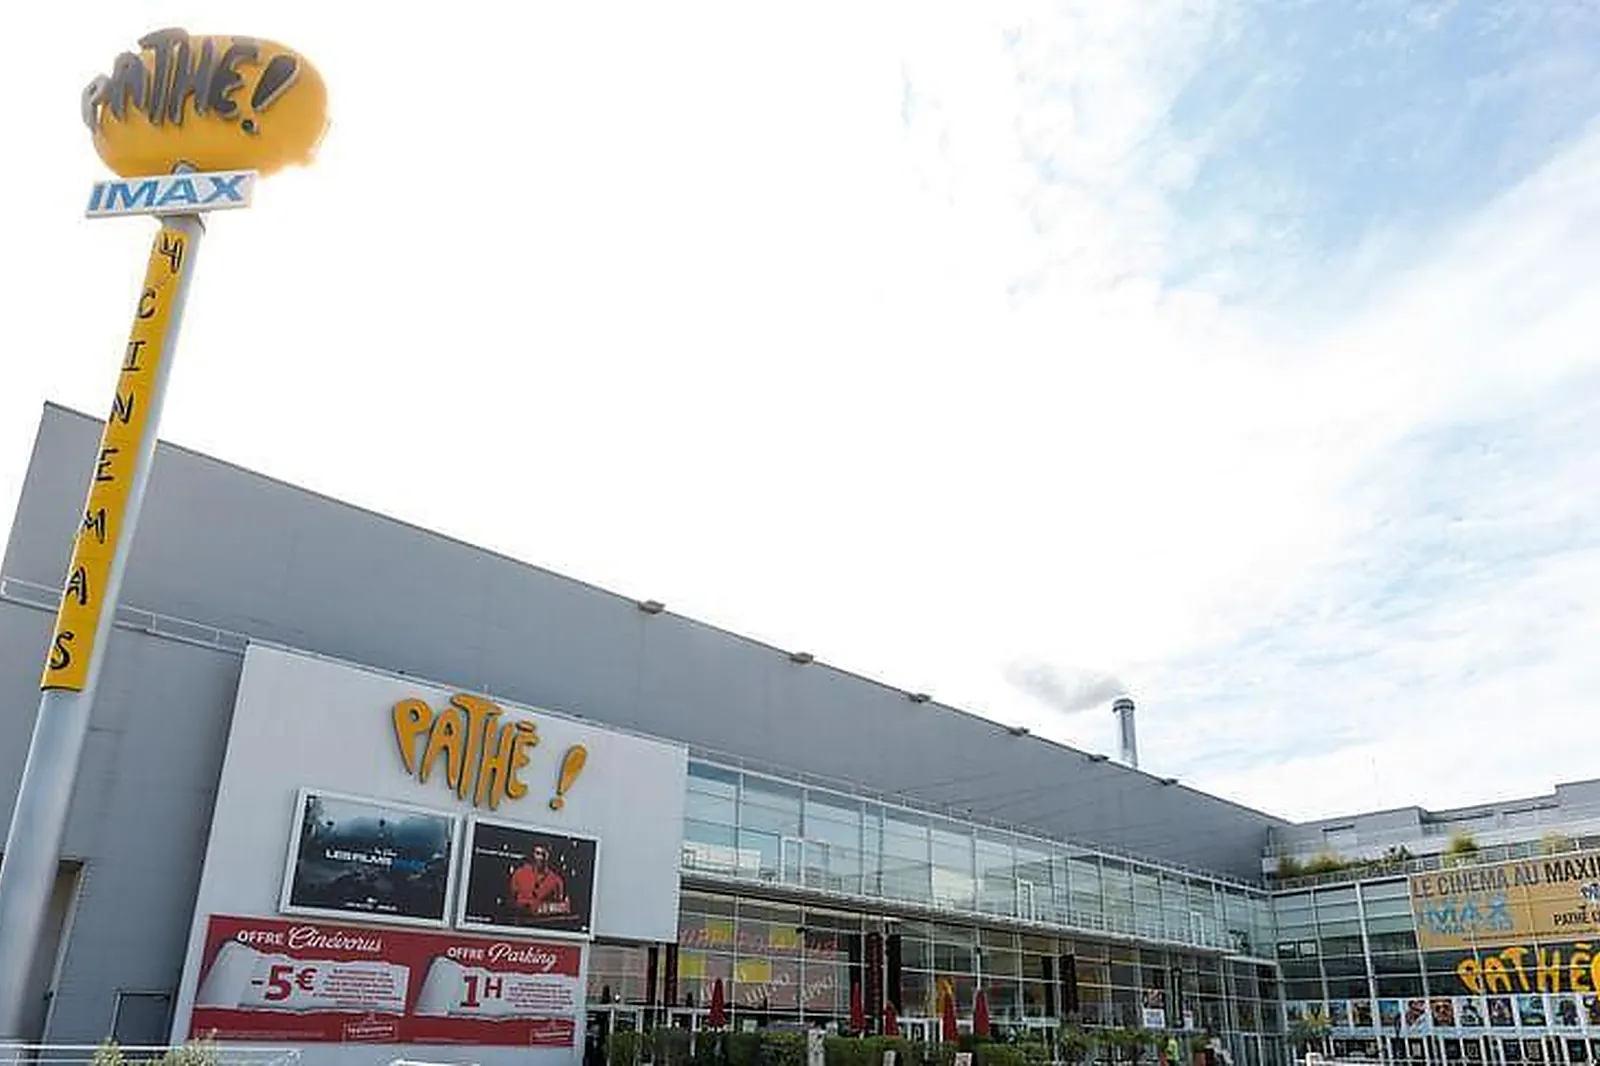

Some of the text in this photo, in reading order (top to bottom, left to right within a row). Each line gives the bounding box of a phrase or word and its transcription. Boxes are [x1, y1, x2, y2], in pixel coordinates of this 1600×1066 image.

[87, 173, 247, 211] IMAX
[48, 232, 184, 671] 4 CINEMAS
[1413, 855, 1600, 898] LE CINEMA AU MAXI
[236, 929, 285, 946] OFFRE
[447, 942, 557, 972] OFFRE Parking
[460, 975, 503, 1008] 1H
